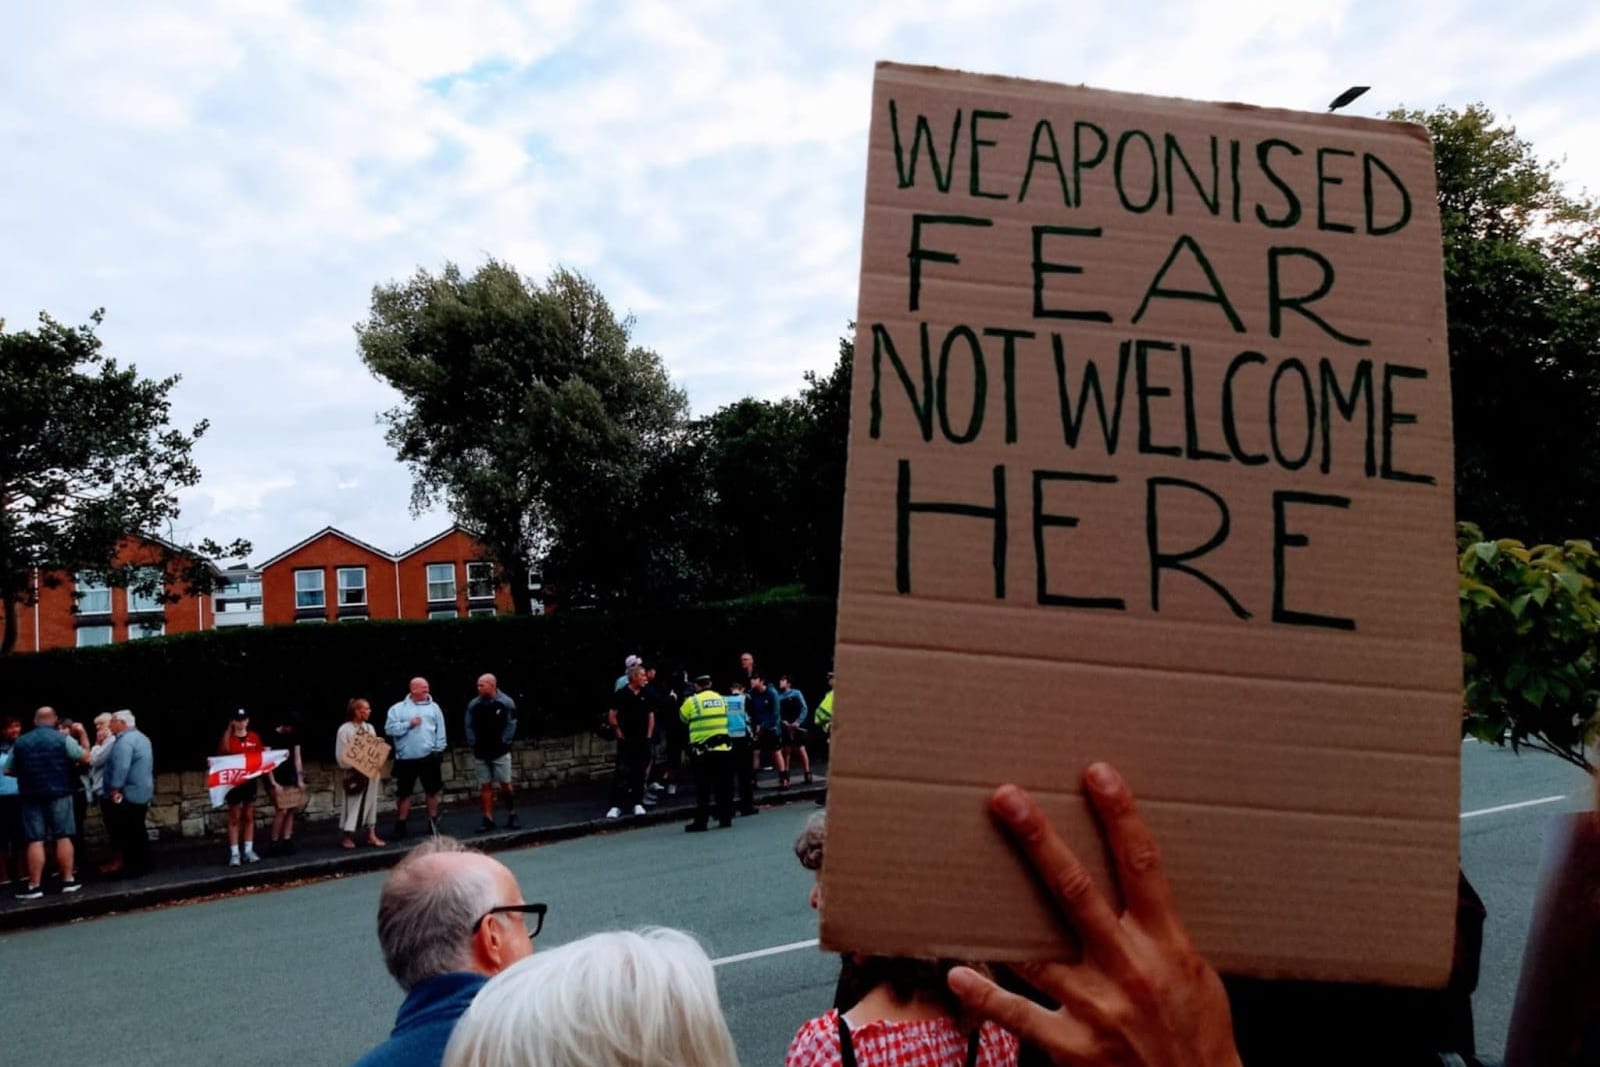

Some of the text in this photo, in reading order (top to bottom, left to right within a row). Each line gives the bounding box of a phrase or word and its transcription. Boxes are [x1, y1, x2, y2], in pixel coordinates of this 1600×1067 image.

[889, 98, 1413, 236] WEAPONISED
[907, 213, 1371, 347] FEAR
[869, 322, 1438, 486] NOT WELCOME
[895, 458, 1356, 631] HERE
[703, 700, 722, 708] POLICE
